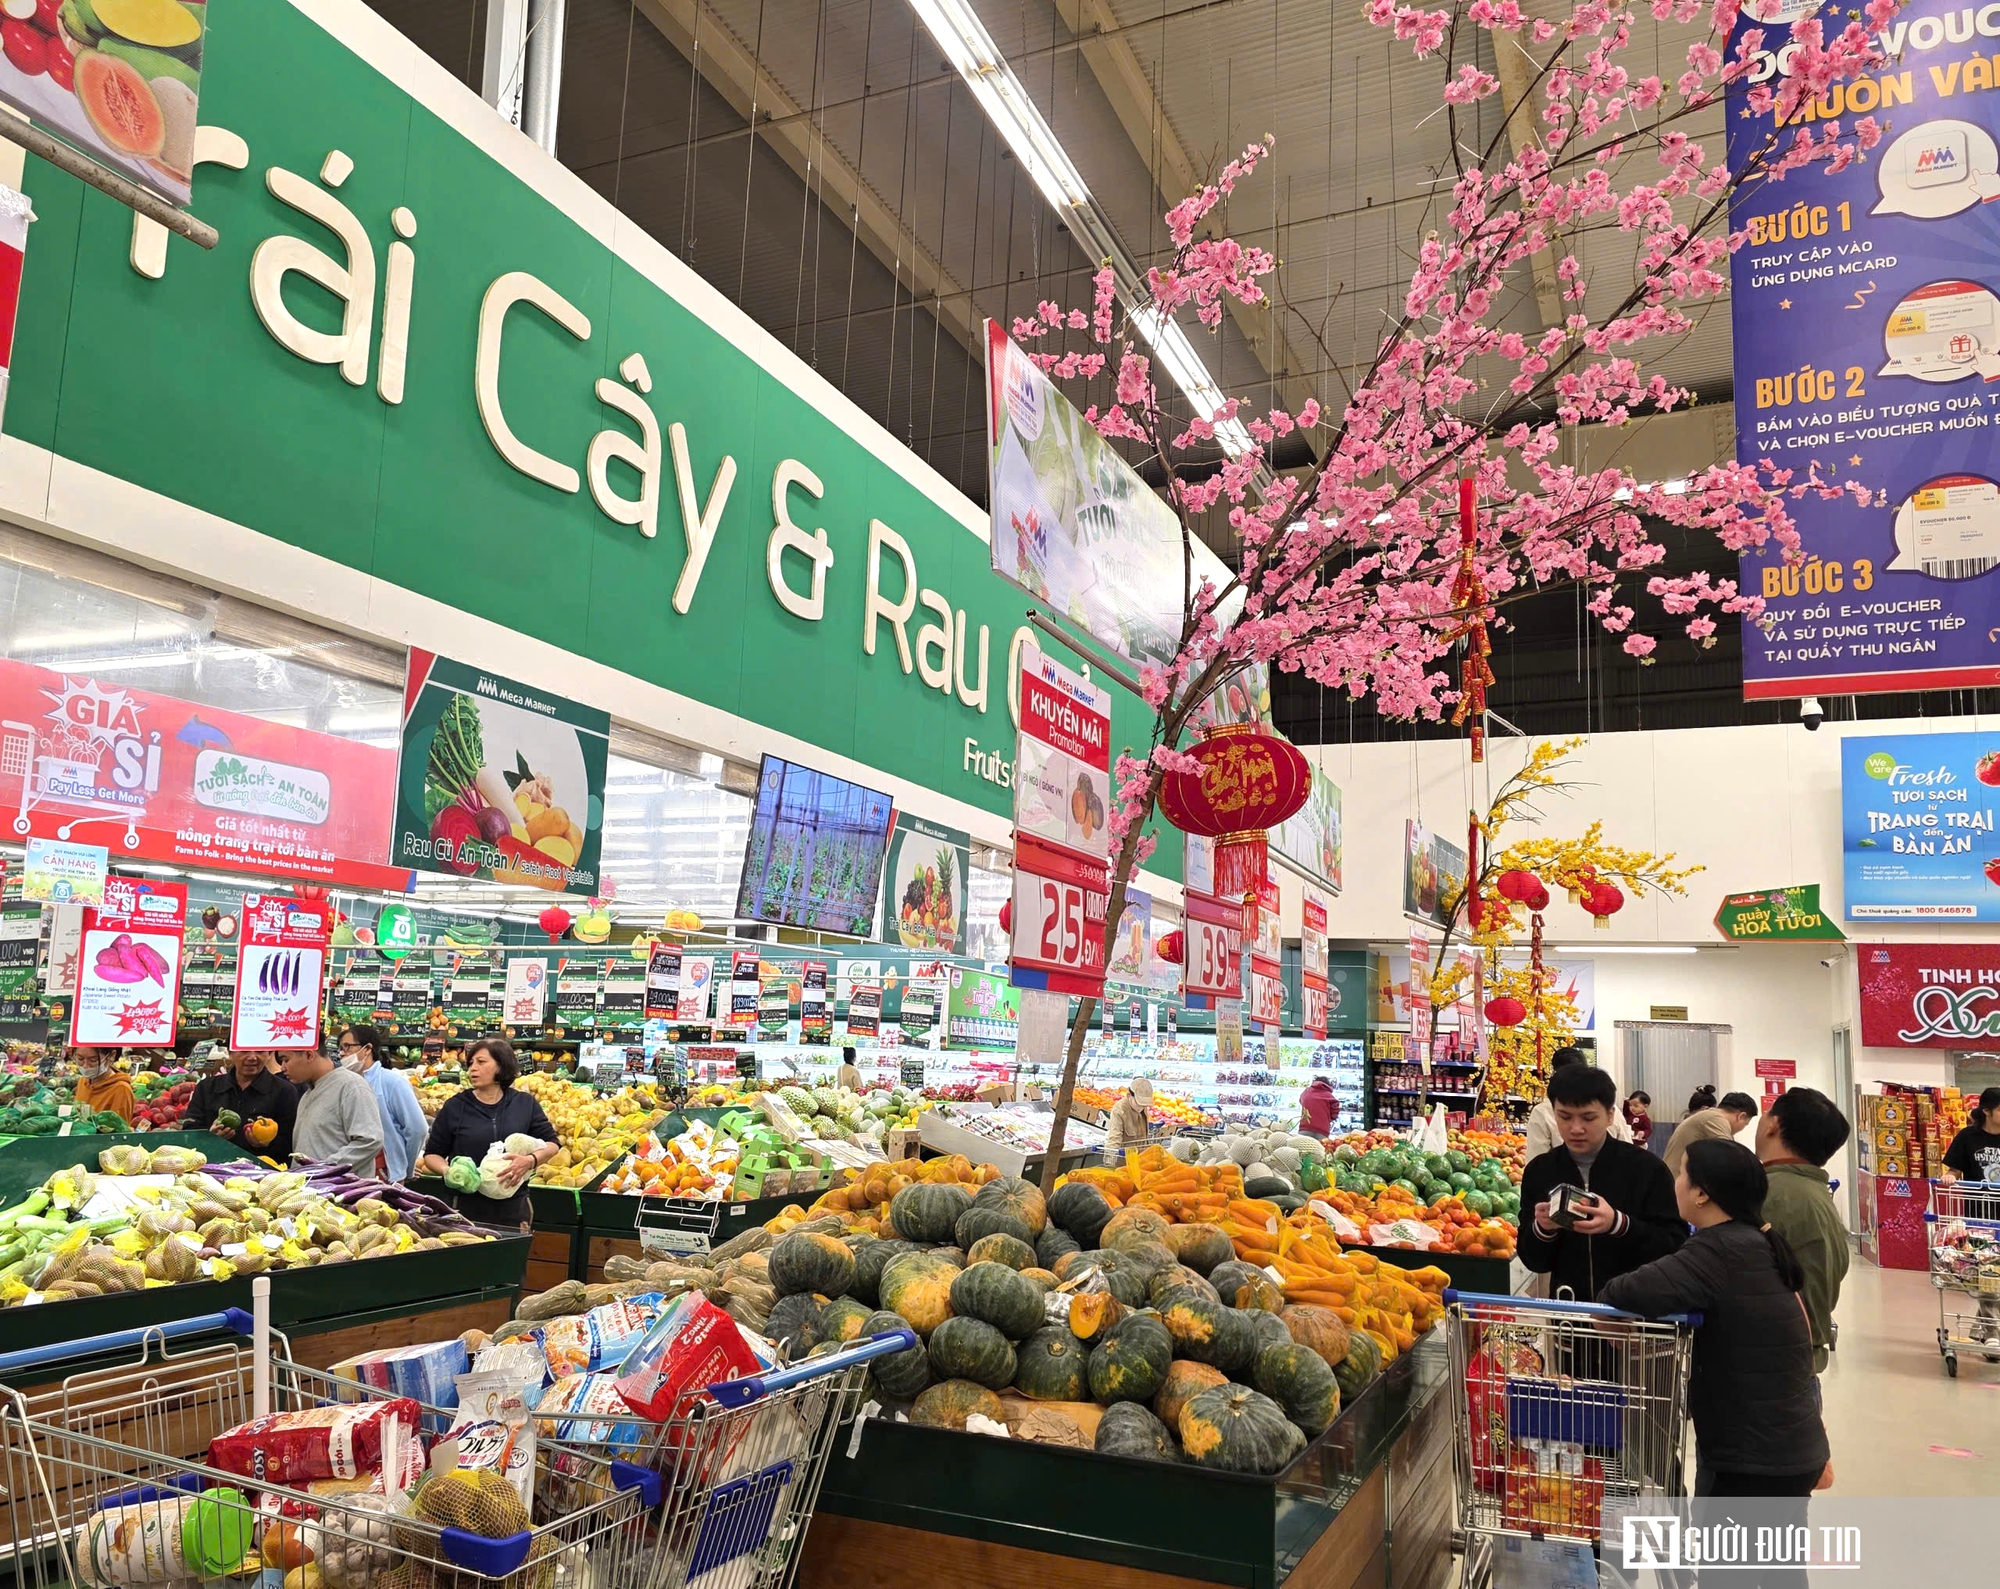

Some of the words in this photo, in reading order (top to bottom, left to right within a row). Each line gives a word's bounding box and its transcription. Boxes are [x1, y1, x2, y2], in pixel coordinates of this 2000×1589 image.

[1751, 200, 1829, 246] BƯỚC
[1836, 201, 1851, 232] 1
[1751, 254, 1794, 270] TRUY
[1799, 246, 1832, 264] CẬP
[1837, 240, 1873, 256] VÀO
[1752, 271, 1785, 288] ỨNG
[1790, 265, 1834, 284] DỤNG
[1839, 255, 1898, 274] MCARD
[1756, 364, 1835, 409] BƯỚC
[1845, 366, 1865, 398] 2
[1757, 416, 1792, 433] BẤM
[1798, 410, 1832, 428] VÀO
[1838, 404, 1875, 423] BIỂU
[1880, 399, 1941, 420] TƯỢNG
[1946, 393, 1982, 411] QUÀ
[1757, 434, 1782, 452] VÀ
[1786, 433, 1830, 450] CHỌN
[1834, 422, 1934, 443] E-VOUCHER
[1939, 413, 1988, 431] MUỐN
[474, 270, 738, 615] Cây
[767, 457, 835, 621] &
[863, 517, 990, 714] Rau
[1762, 555, 1844, 598] BƯỚC
[1853, 559, 1874, 591] 3
[1802, 602, 1830, 620] ĐỔI
[1840, 599, 1942, 618] E-VOUCHER
[1764, 624, 1788, 642] VÀ
[1793, 624, 1817, 640] SỬ
[1823, 624, 1868, 641] DỤNG
[1874, 618, 1922, 638] TRỰC
[1927, 614, 1966, 630] TIẾP
[1765, 650, 1792, 664] TẠI
[1849, 642, 1884, 656] THU
[1889, 639, 1936, 655] NGÂN
[500, 690, 524, 705] Mega
[524, 696, 556, 716] Market
[1057, 675, 1073, 695] Mega
[1074, 685, 1095, 707] Market
[1030, 688, 1079, 736] KHUYẾN
[1081, 715, 1102, 749] MÃI
[1048, 728, 1085, 759] Promotion
[112, 731, 161, 792] SỈ
[963, 735, 1011, 789] Fruits
[1869, 758, 1887, 767] We
[1874, 766, 1892, 774] are
[1887, 765, 1956, 786] Fresh
[50, 779, 71, 794] Pay
[73, 782, 95, 796] Less
[99, 787, 116, 800] Get
[118, 791, 145, 805] More
[197, 775, 228, 793] TƯƠI
[233, 774, 265, 788] SẠCH
[278, 779, 294, 793] AN
[299, 786, 327, 811] TOÀN
[1892, 790, 1924, 804] TƯƠI
[1928, 788, 1967, 804] SẠCH
[215, 816, 236, 831] Giá
[240, 819, 259, 835] tốt
[261, 823, 290, 839] nhất
[292, 828, 307, 842] từ
[1867, 811, 1939, 834] TRANG
[1945, 809, 1994, 836] TRẠI
[1923, 828, 1944, 836] đến
[176, 828, 211, 847] nông
[214, 833, 250, 852] trang
[252, 839, 275, 856] trại
[277, 842, 294, 856] tới
[296, 845, 319, 860] bàn
[320, 850, 335, 862] ăn
[1893, 832, 1934, 855] BÀN
[1941, 834, 1971, 854] ĂN
[68, 857, 96, 870] HÀNG
[175, 846, 193, 855] Farm
[204, 849, 219, 859] Folk
[226, 853, 244, 863] Bring
[245, 856, 256, 864] the
[258, 857, 272, 866] best
[273, 860, 292, 870] prices
[312, 865, 334, 874] market
[403, 833, 430, 858] Rau
[434, 839, 454, 861] Củ
[457, 842, 476, 864] An
[479, 845, 508, 869] Toàn
[520, 860, 544, 879] Safety
[545, 864, 562, 880] Root
[562, 866, 594, 886] Vegetable
[1041, 881, 1082, 968] 25
[1732, 922, 1772, 936] HOA
[1775, 913, 1822, 931] TƯƠI
[1737, 907, 1771, 923] quầy
[1201, 926, 1229, 988] 39
[1918, 969, 1971, 983] TINH
[1260, 974, 1274, 1019] 39
[689, 1316, 708, 1336] TẶNG
[694, 1331, 707, 1345] 10
[707, 1316, 718, 1333] MUA
[681, 1334, 692, 1345] 2
